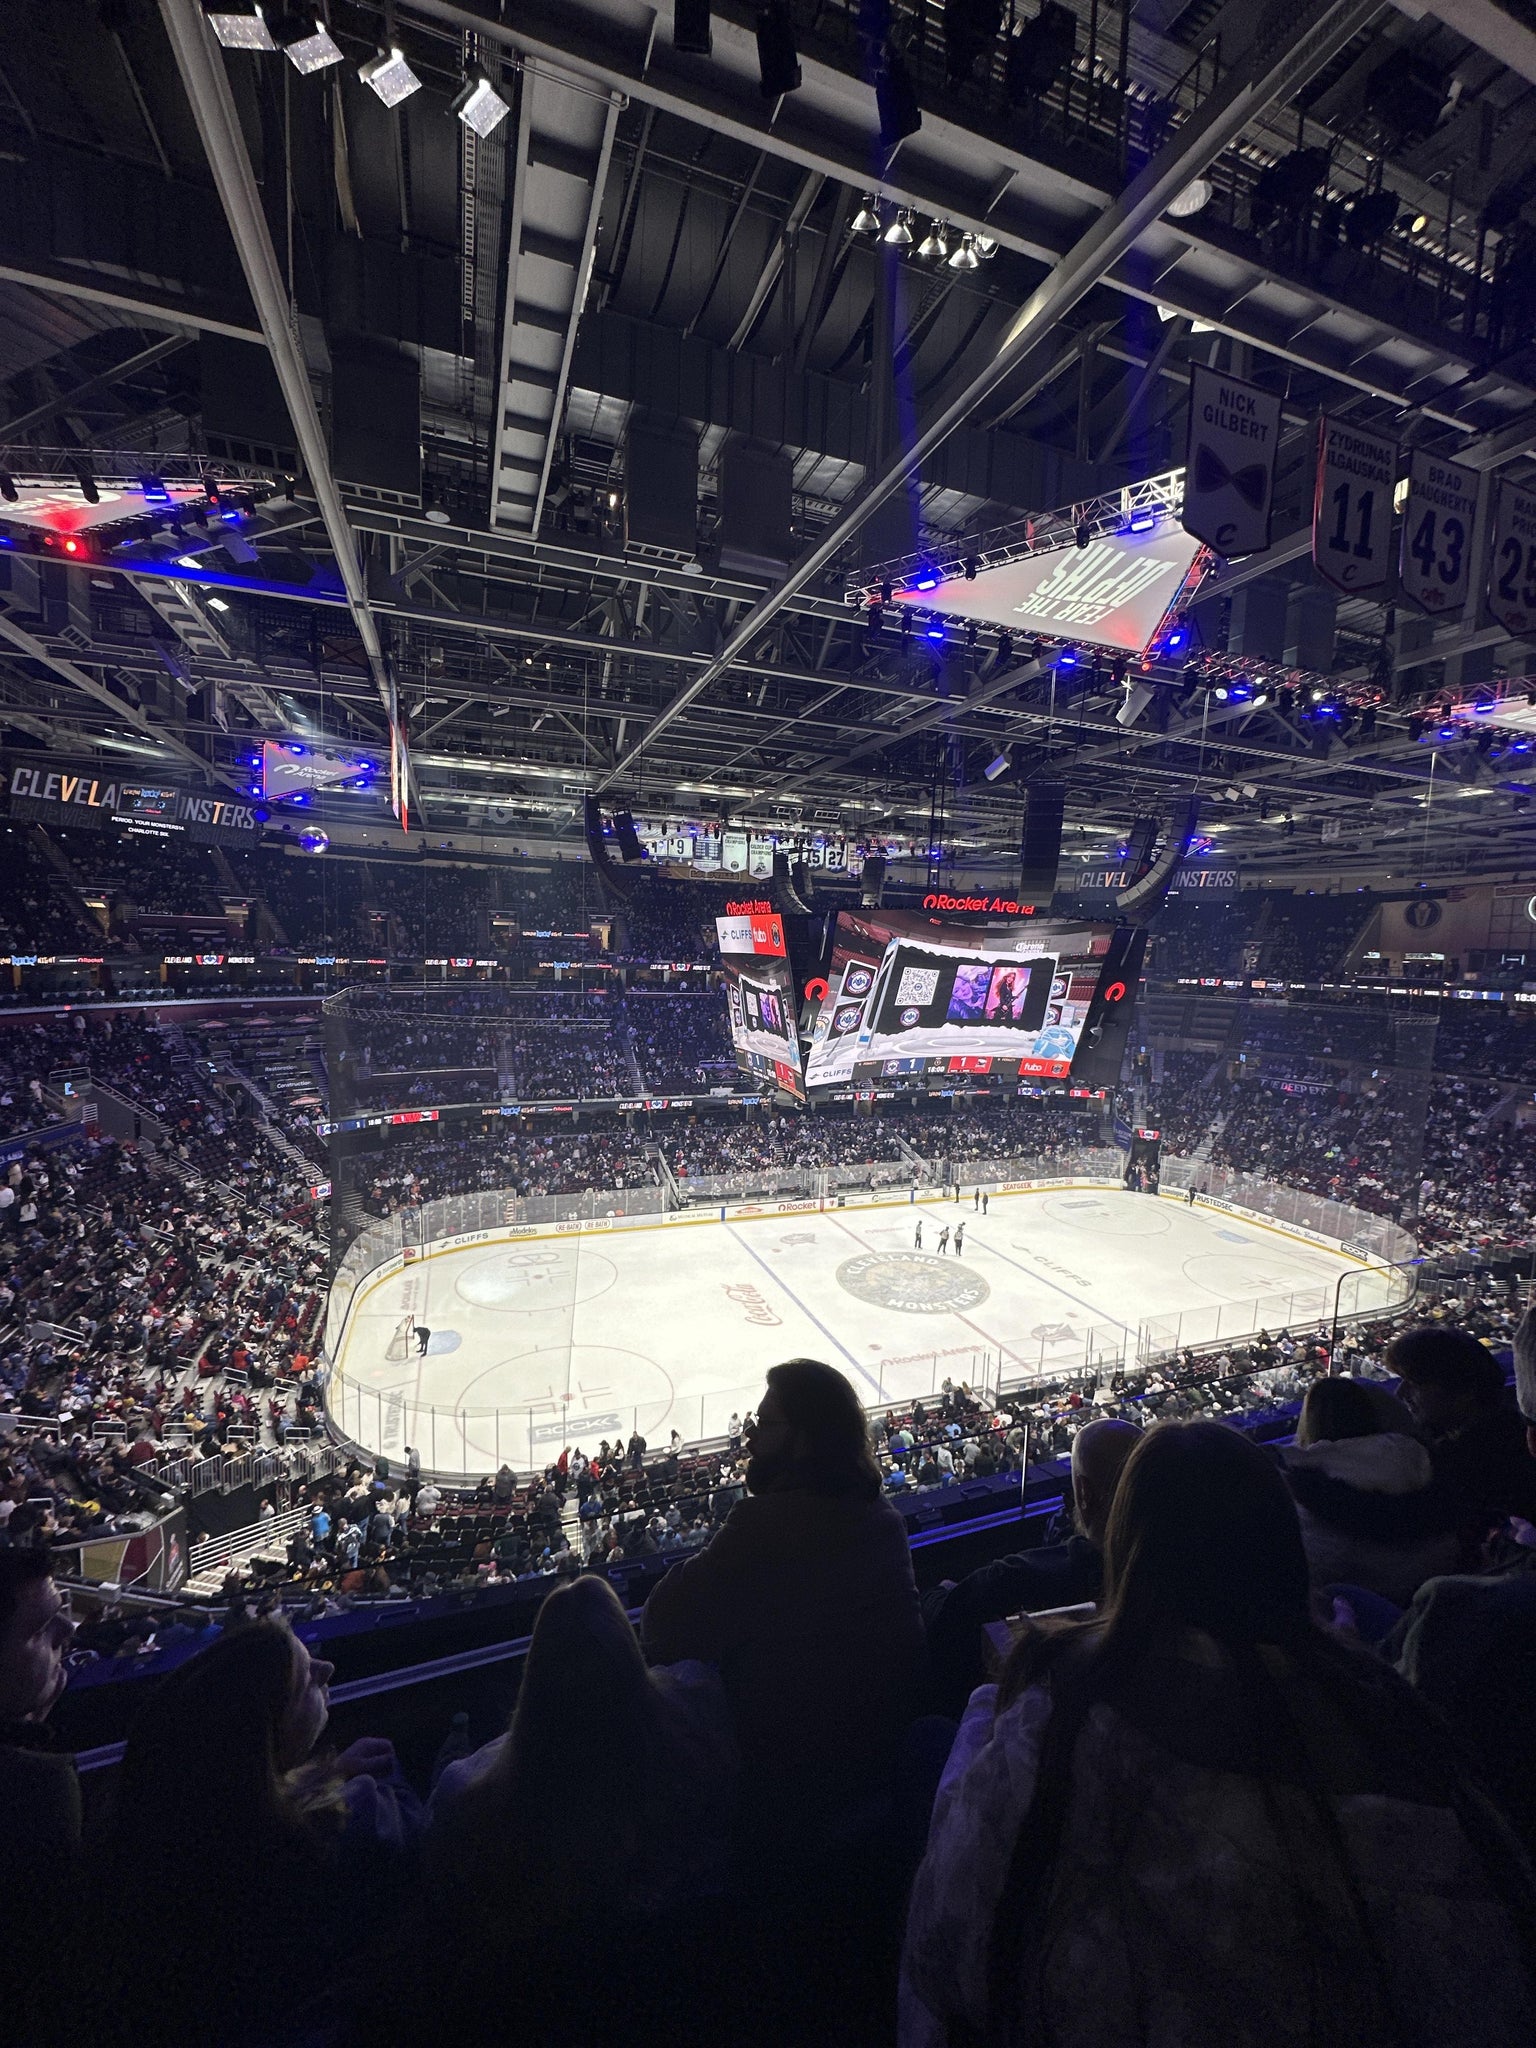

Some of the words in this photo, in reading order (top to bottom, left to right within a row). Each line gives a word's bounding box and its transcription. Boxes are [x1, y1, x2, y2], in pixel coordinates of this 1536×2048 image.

[1218, 387, 1256, 416] NICK
[1203, 404, 1269, 442] GILBERT
[1328, 430, 1393, 467] ZYDRUNAS
[1428, 466, 1462, 492] BRAD
[1411, 480, 1476, 516] DAUGHERTY
[1328, 483, 1375, 560] 11
[1411, 509, 1466, 585] 43
[1012, 592, 1060, 618] THE
[1052, 599, 1116, 626] FEAR
[300, 765, 338, 777] Rocket
[10, 767, 116, 809] CLEVELA
[128, 827, 159, 836] CHARLOTTE
[676, 839, 684, 855] 9
[828, 851, 844, 866] 27
[732, 900, 754, 916] Rocket
[754, 899, 772, 914] Arena
[937, 894, 989, 911] Rocket
[989, 897, 1035, 915] Arena
[731, 929, 753, 940] CLIFFS
[753, 927, 767, 943] fubo
[1015, 942, 1045, 952] Corona
[164, 956, 193, 964] CLEVELAND
[1408, 988, 1419, 996] 14
[1481, 991, 1487, 1000] 1
[755, 1055, 760, 1066] 1
[909, 1058, 916, 1069] 1
[960, 1057, 967, 1067] 1
[1024, 1062, 1042, 1071] fubo
[780, 1064, 784, 1075] 1
[823, 1067, 852, 1078] CLIFFS
[1280, 1082, 1307, 1093] DEEP
[1002, 1181, 1032, 1191] SEATGEEK
[786, 1200, 817, 1211] Rocket
[1196, 1193, 1233, 1212] RUSTEDSEC
[558, 1222, 579, 1231] RE-BATH
[453, 1232, 489, 1245] CLIFFS
[846, 1254, 939, 1275] CLEVELAND
[1033, 1254, 1092, 1289] CLIFFS
[887, 1288, 980, 1311] MONSTERS
